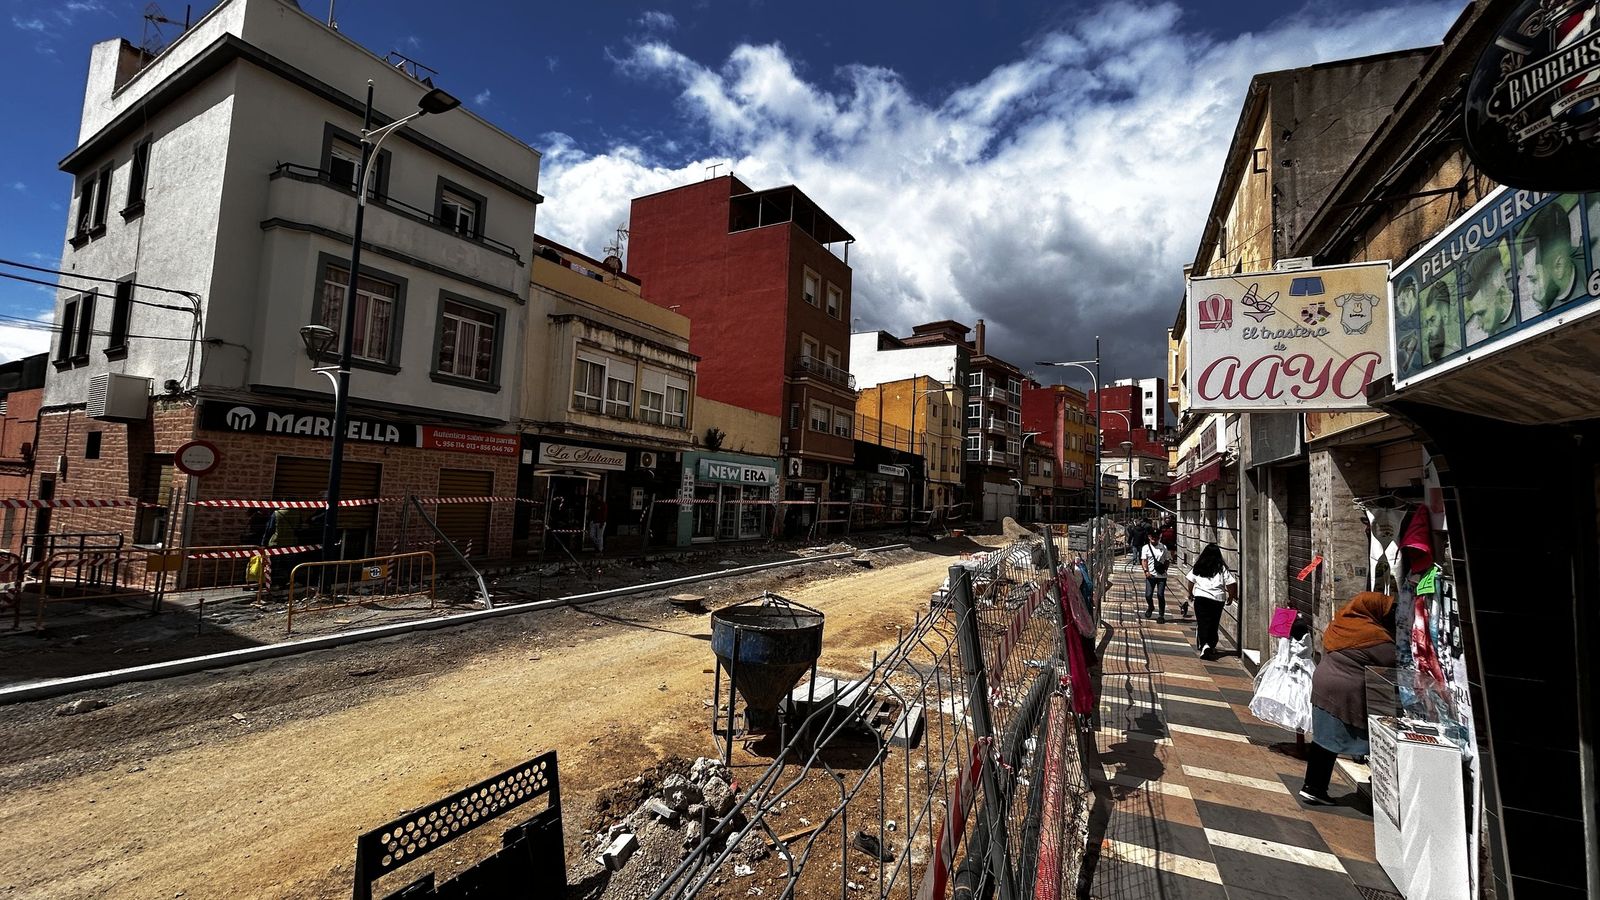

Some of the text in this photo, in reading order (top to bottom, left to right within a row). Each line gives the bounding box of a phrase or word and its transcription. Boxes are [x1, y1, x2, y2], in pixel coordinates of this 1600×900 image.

[1242, 325, 1331, 340] El trastero
[1273, 341, 1287, 351] de
[265, 411, 400, 443] MARELLA
[442, 440, 455, 448] 956
[455, 441, 465, 449] 114
[544, 444, 624, 466] La Sultana
[709, 465, 767, 482] NEW ERA
